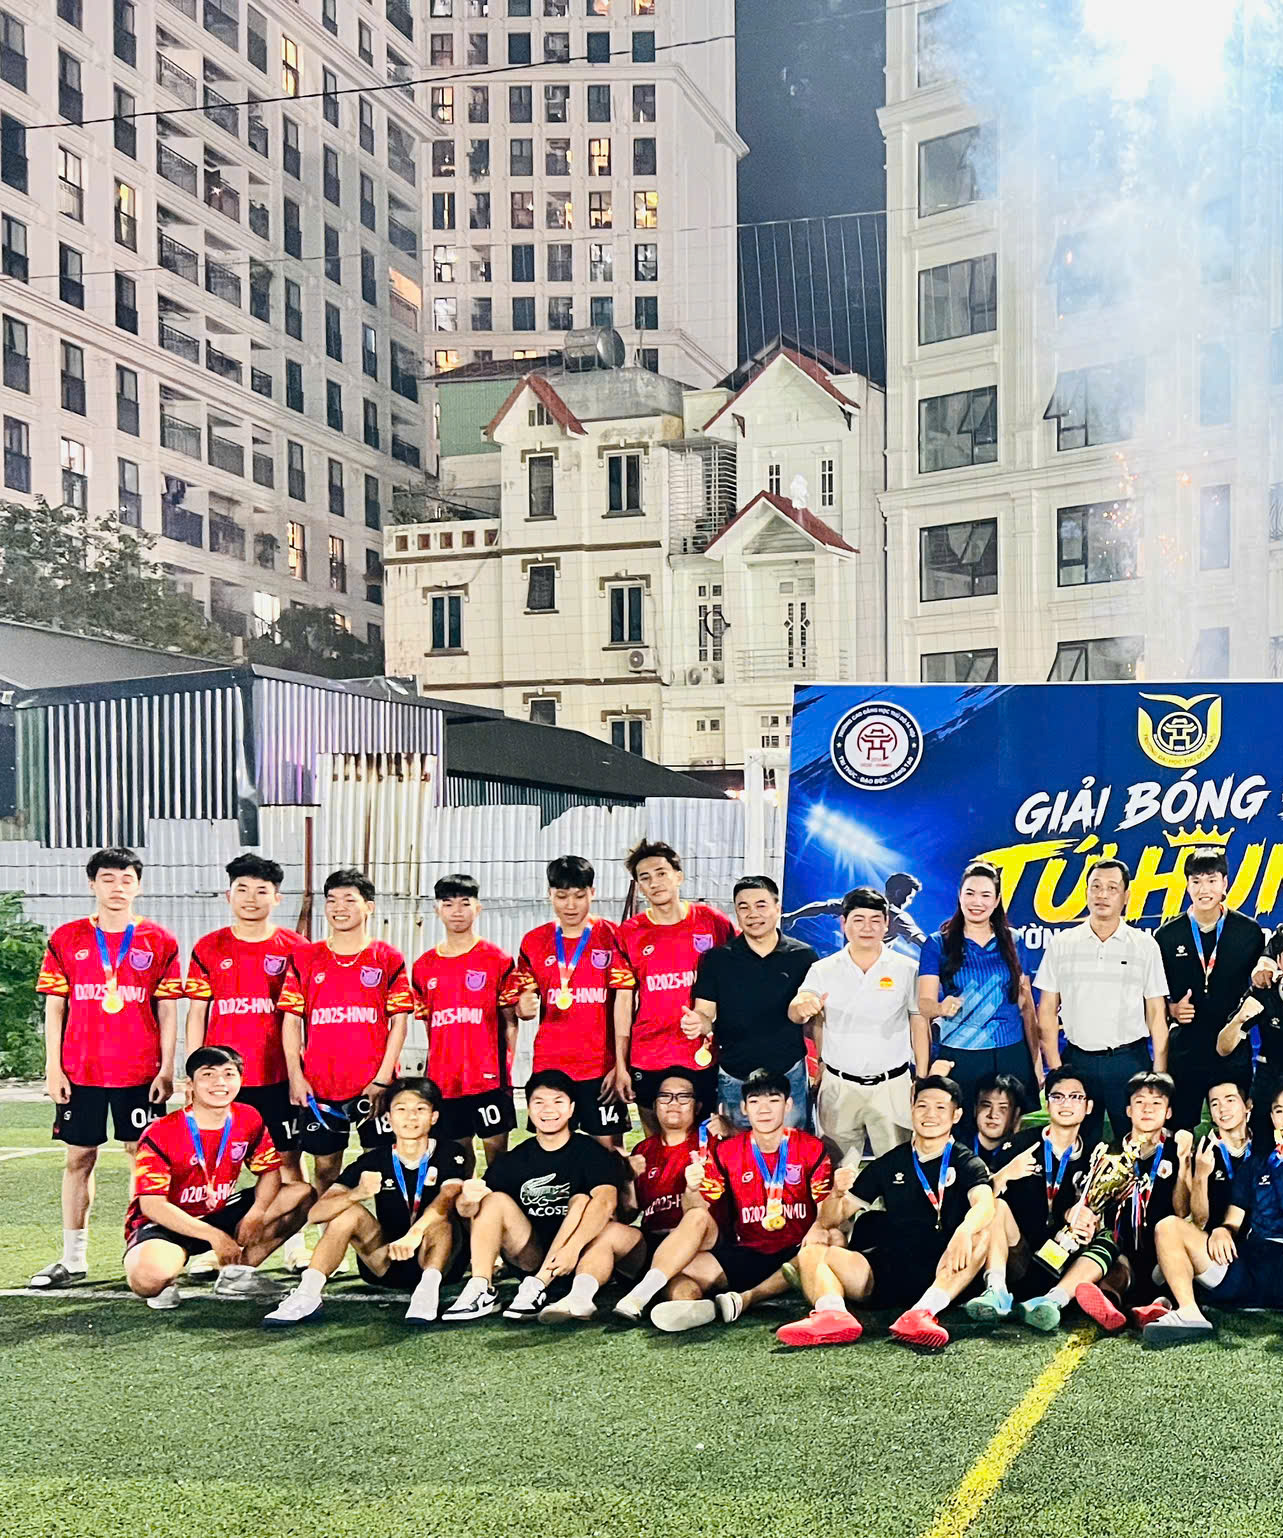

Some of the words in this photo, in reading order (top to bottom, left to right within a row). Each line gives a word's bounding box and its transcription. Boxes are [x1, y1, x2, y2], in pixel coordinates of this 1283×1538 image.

[1014, 775, 1111, 838] GIẢI
[1113, 768, 1272, 832] BÓNG
[478, 1104, 502, 1127] 10
[599, 1105, 620, 1126] 14
